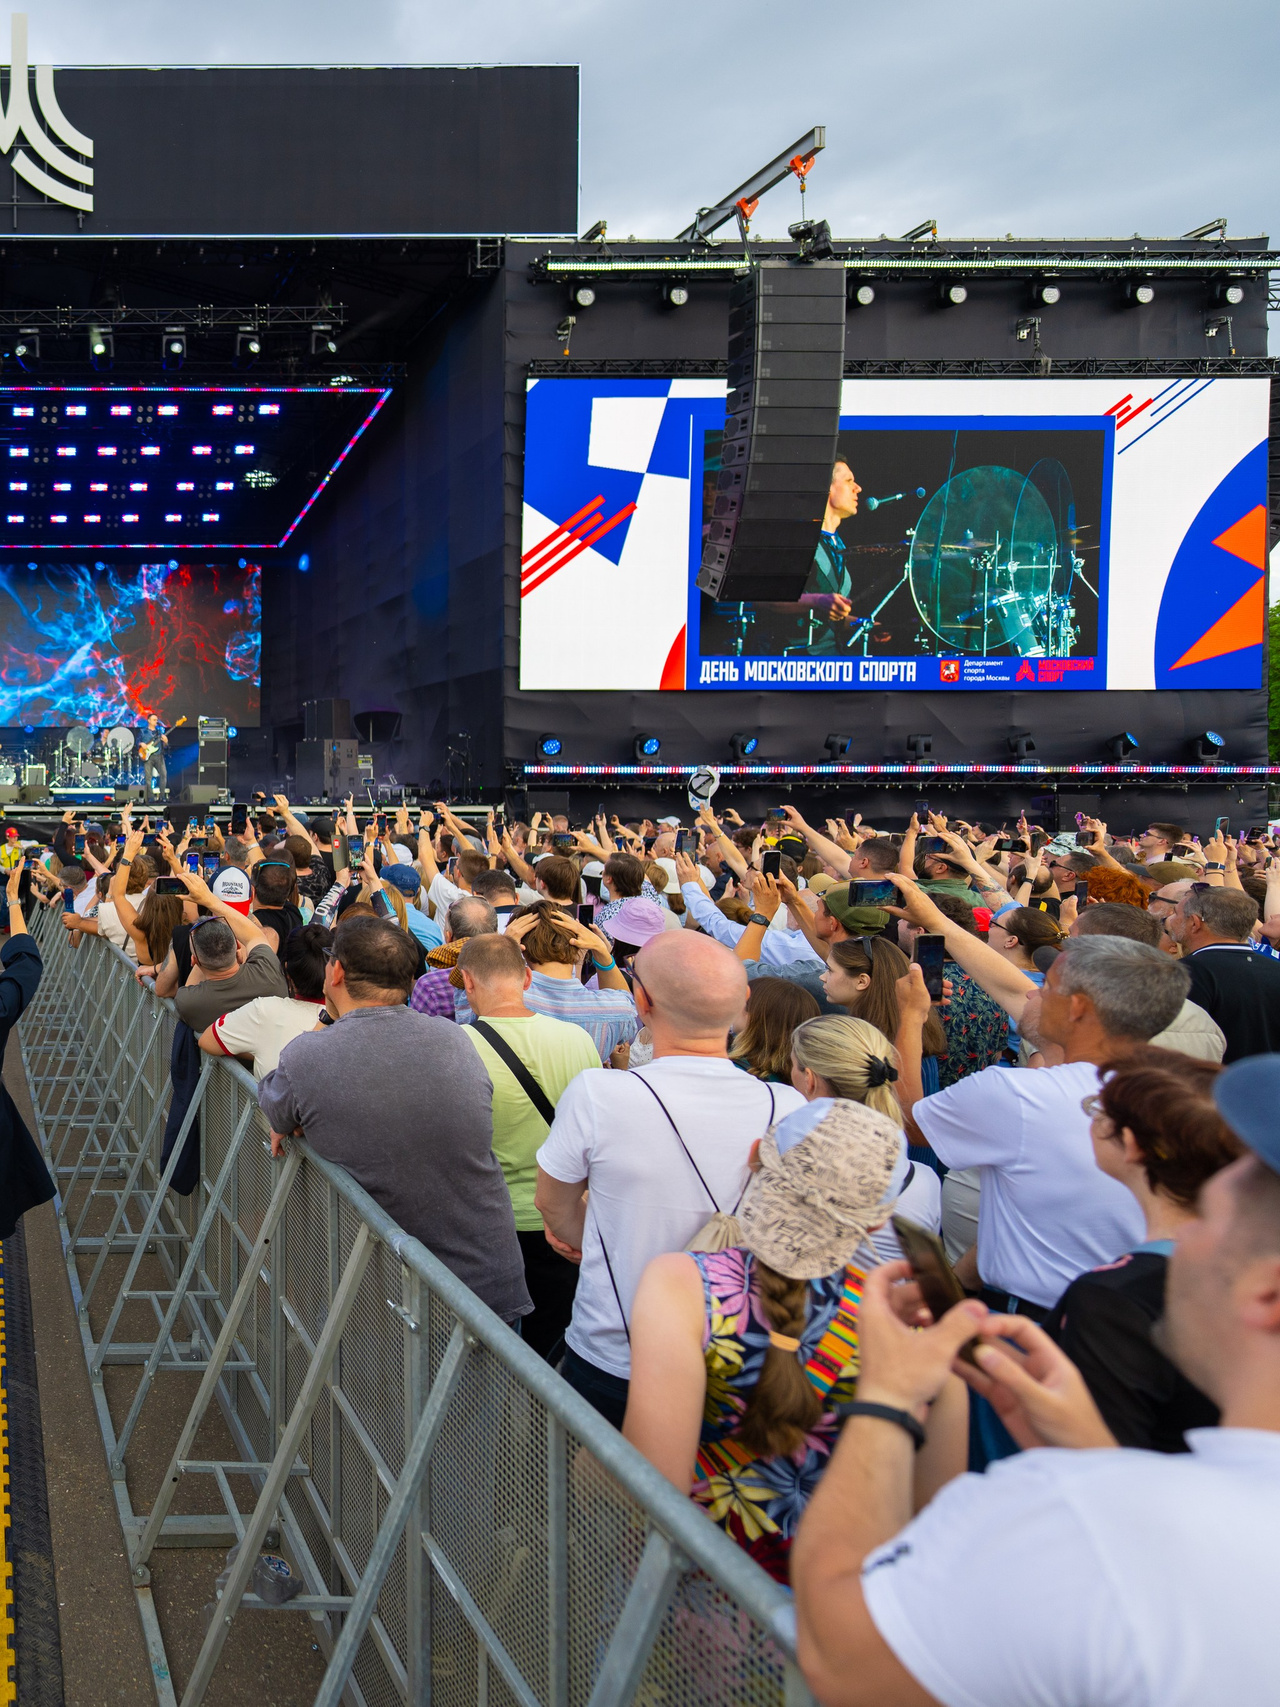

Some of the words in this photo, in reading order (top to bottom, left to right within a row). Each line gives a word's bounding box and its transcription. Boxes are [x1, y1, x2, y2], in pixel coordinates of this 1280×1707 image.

[963, 659, 1003, 667] Департамент
[699, 661, 739, 684] ДЕНЬ
[744, 661, 853, 682] МОСКОВСКОГО
[859, 661, 917, 682] СПОРТА
[963, 667, 985, 675] спорта
[1038, 671, 1064, 682] СПОРТ
